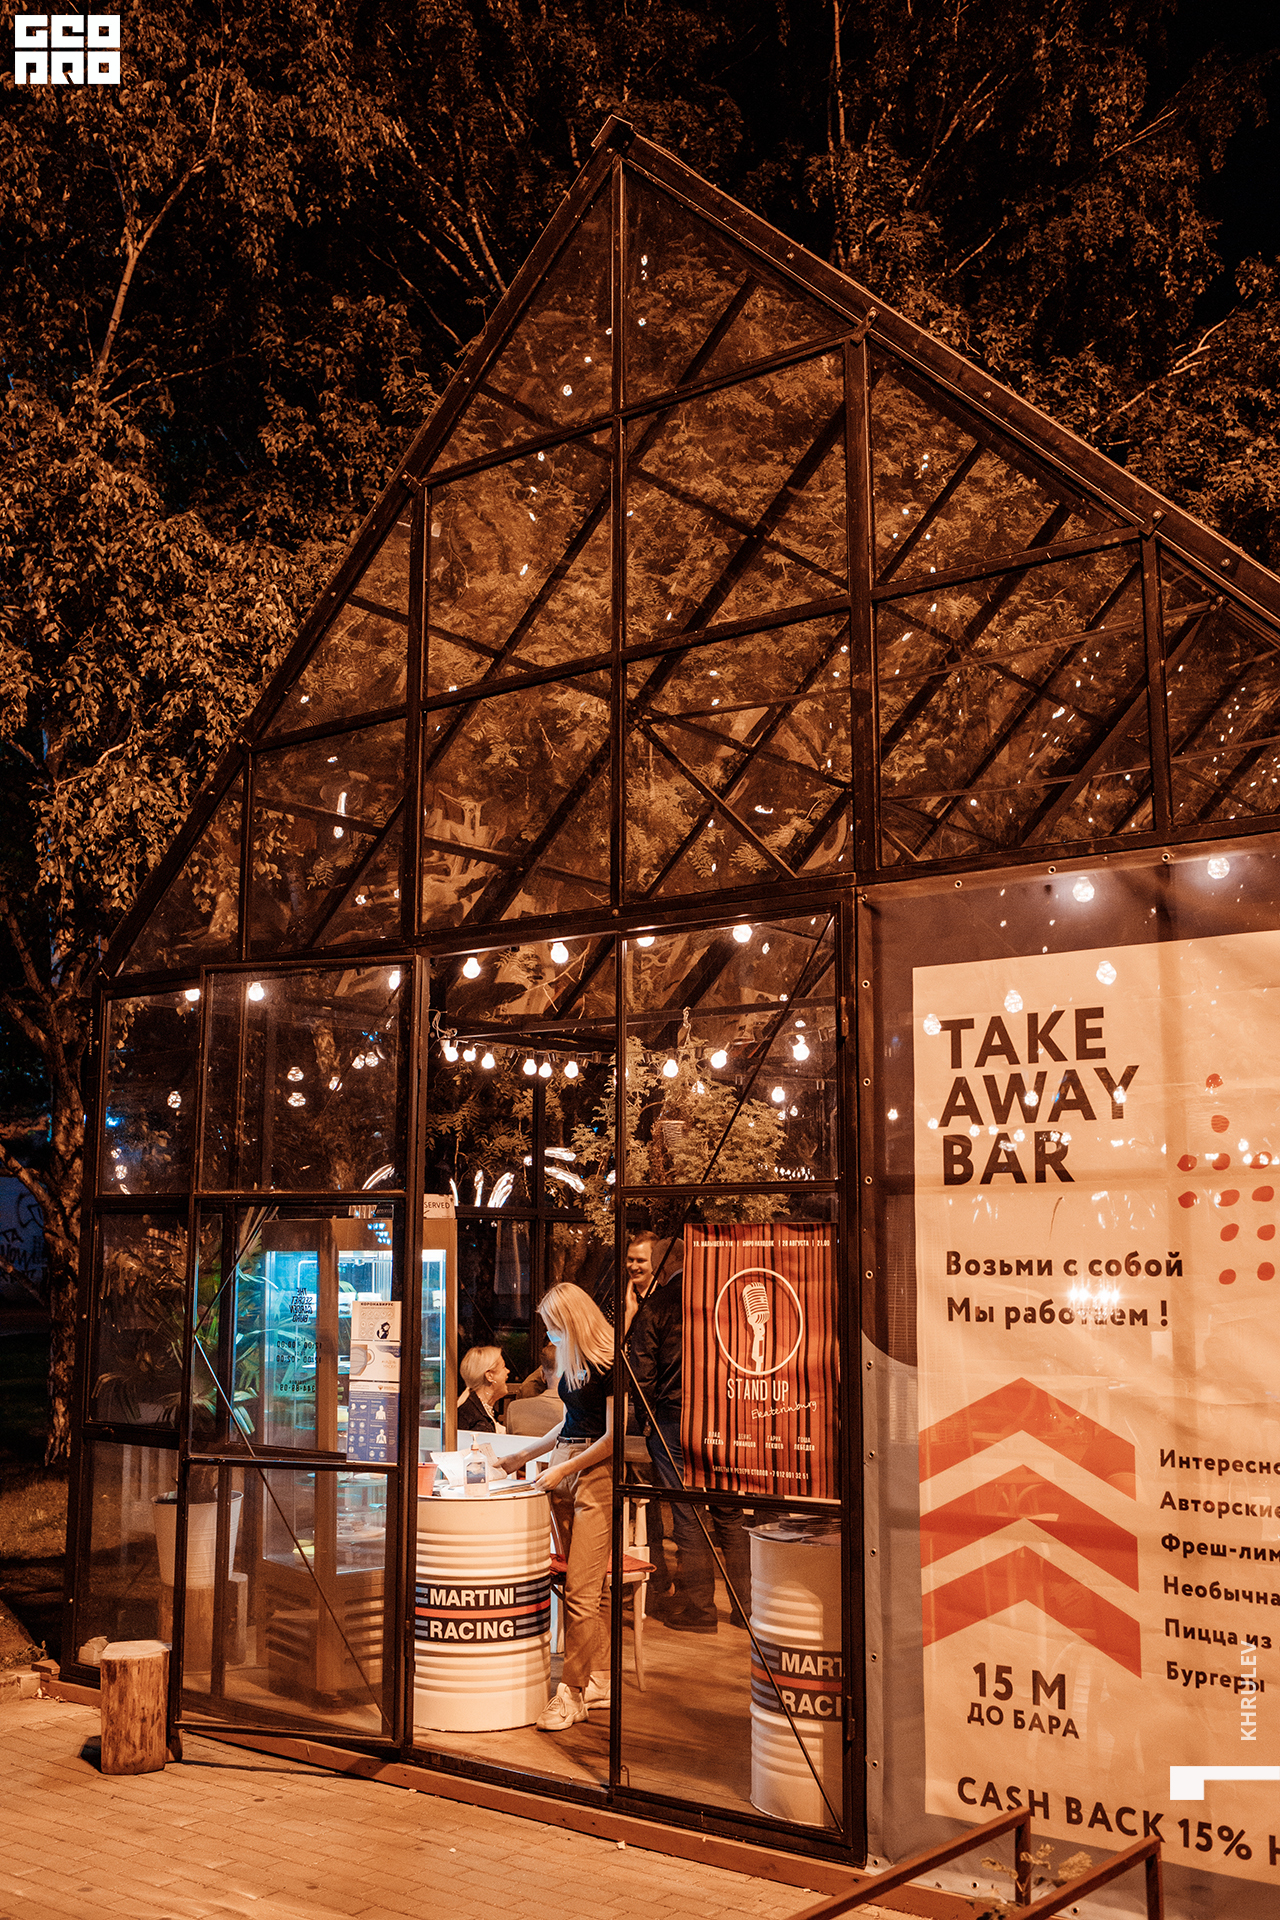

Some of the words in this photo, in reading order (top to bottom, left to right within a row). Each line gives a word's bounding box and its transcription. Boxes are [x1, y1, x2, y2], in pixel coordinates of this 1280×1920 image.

[940, 1007, 1106, 1069] TAKE
[938, 1065, 1140, 1128] AWAY
[942, 1130, 1076, 1186] BAR
[755, 1240, 774, 1248] НАХОДОК
[789, 1239, 809, 1247] АВГУСТА
[946, 1251, 1053, 1276] Возьми
[1063, 1259, 1078, 1276] с
[1088, 1250, 1183, 1277] собой
[947, 1297, 994, 1322] Мы
[727, 1378, 768, 1401] STAND
[773, 1380, 789, 1402] UP
[751, 1401, 817, 1420] Ekaterinburg
[794, 1444, 815, 1452] ЛЕБЕДЕВ
[798, 1436, 811, 1444] ГОША
[430, 1587, 515, 1607] MARTINI
[1163, 1575, 1280, 1607] Необычна
[430, 1620, 515, 1640] RACING
[1165, 1618, 1238, 1646] Пицца
[1246, 1634, 1272, 1649] из
[973, 1662, 1013, 1701] 15
[1032, 1670, 1066, 1710] М
[1166, 1661, 1265, 1694] Бургеры
[967, 1702, 1004, 1726] ДО
[1013, 1709, 1080, 1739] БАРА
[957, 1776, 1050, 1820] CASH
[1065, 1796, 1166, 1843] BACK
[1178, 1818, 1253, 1860] 15%
